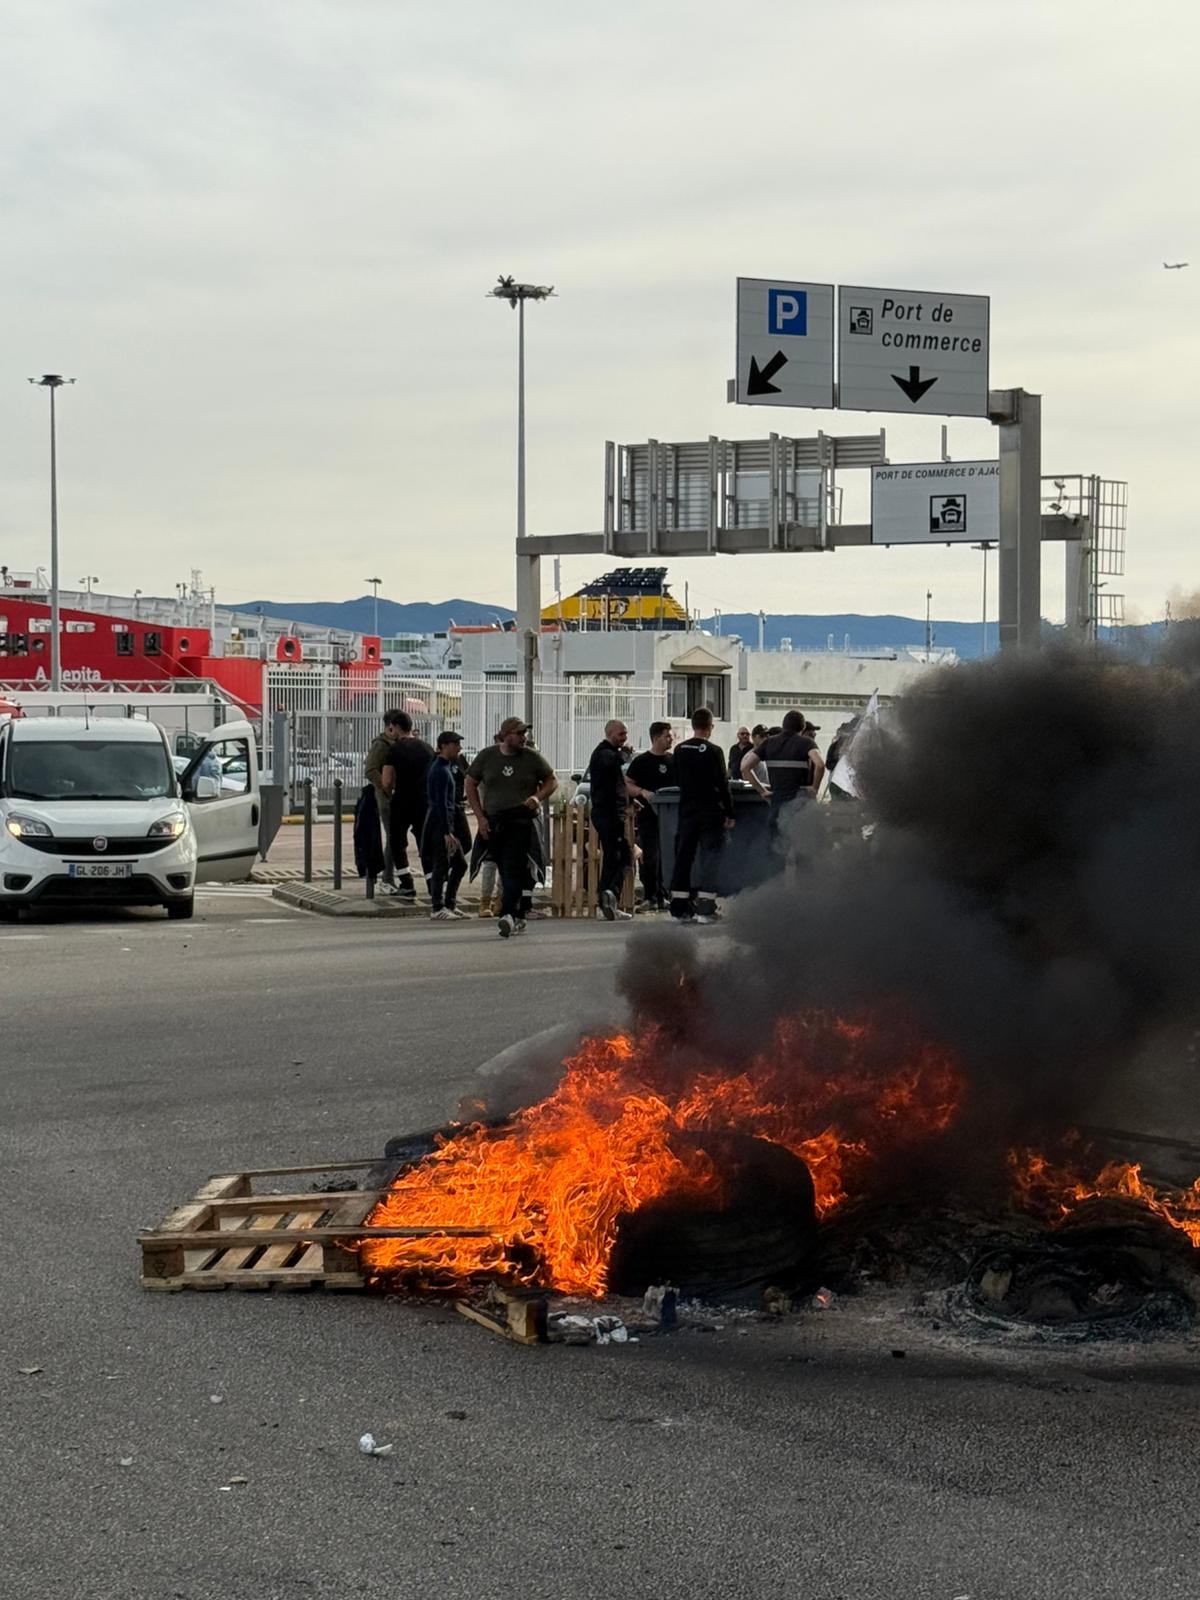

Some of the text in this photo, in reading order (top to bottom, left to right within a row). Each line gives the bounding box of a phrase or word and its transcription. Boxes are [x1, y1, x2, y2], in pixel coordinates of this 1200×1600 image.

[776, 294, 799, 330] P
[881, 299, 953, 323] Port de
[882, 332, 982, 353] commerce
[875, 471, 899, 480] PORT
[901, 470, 913, 479] DE
[915, 468, 966, 479] COMMERCE
[35, 665, 102, 682] A epita
